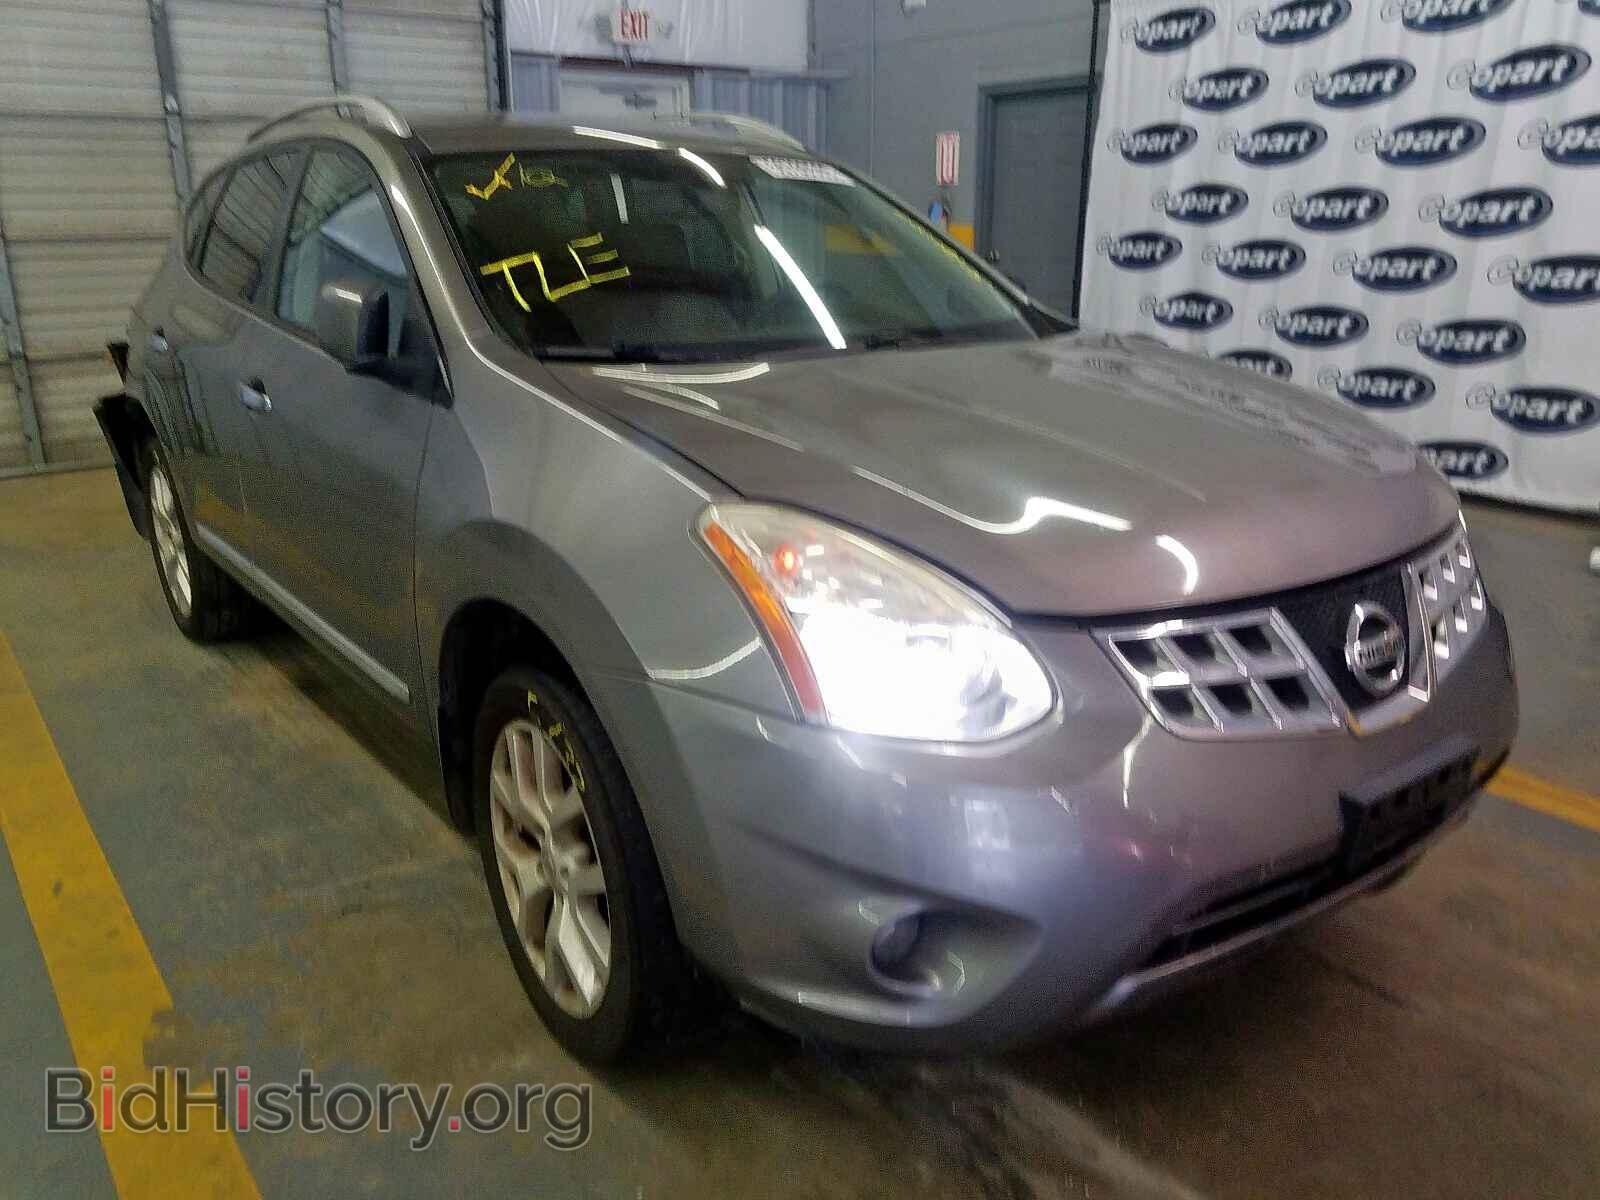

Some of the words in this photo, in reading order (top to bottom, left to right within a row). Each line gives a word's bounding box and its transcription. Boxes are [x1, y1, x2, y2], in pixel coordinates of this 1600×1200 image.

[1120, 14, 1200, 46] Copart
[1236, 2, 1333, 37] Copart
[1168, 74, 1253, 102] Copart
[1294, 67, 1397, 99] Copart
[1446, 54, 1568, 93] Copart
[1105, 128, 1181, 156] Copart
[1218, 128, 1308, 157] Copart
[1354, 125, 1464, 157] Copart
[1152, 189, 1231, 215] Copart
[1272, 192, 1370, 222] Copart
[1418, 193, 1534, 228] Copart
[1096, 232, 1165, 261] Copart
[1201, 241, 1289, 271] Copart
[1333, 249, 1436, 282] Copart
[1139, 296, 1216, 323] Copart
[1258, 306, 1350, 336] Copart
[1396, 319, 1509, 351] Copart
[1317, 366, 1416, 400] Copart
[1465, 383, 1583, 424] Copart
